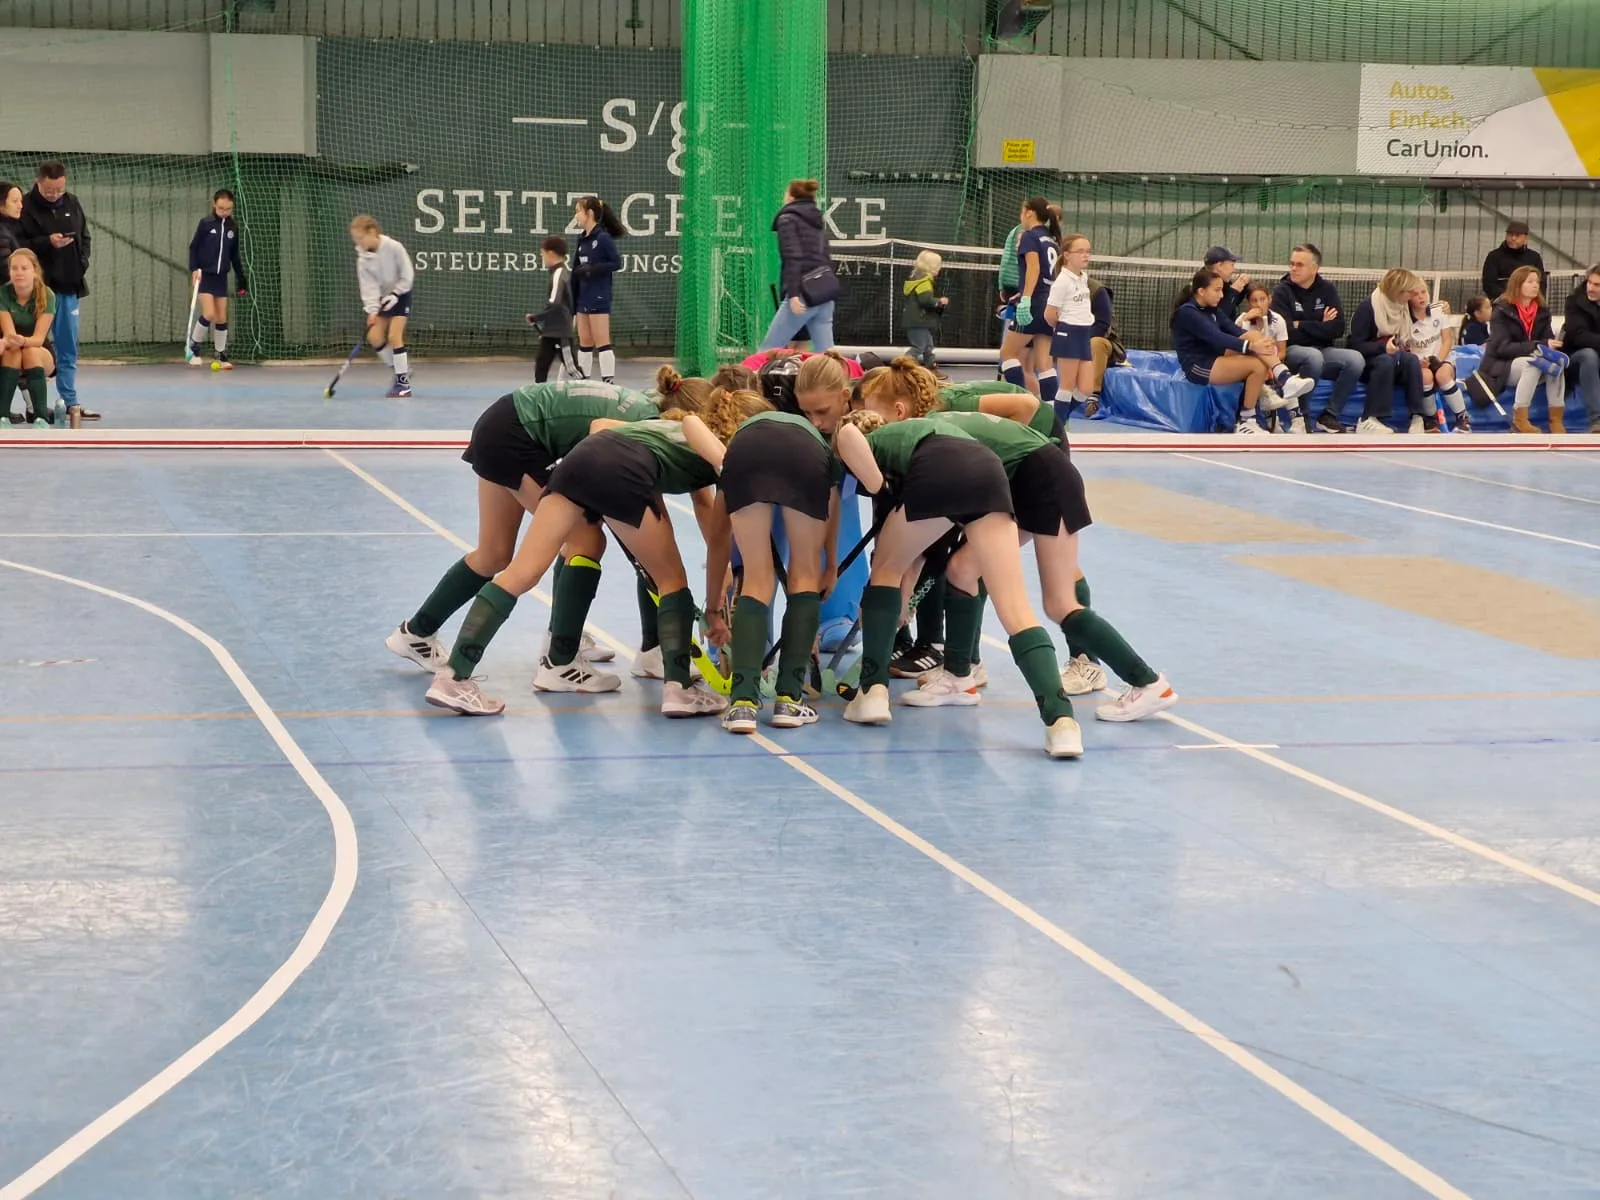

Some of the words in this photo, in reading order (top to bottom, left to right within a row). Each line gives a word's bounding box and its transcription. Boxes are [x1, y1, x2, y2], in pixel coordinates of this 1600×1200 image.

[1389, 80, 1456, 100] Autos.
[1389, 109, 1471, 129] Einfach.
[1386, 138, 1489, 159] CarUnion.
[1046, 246, 1058, 276] 9
